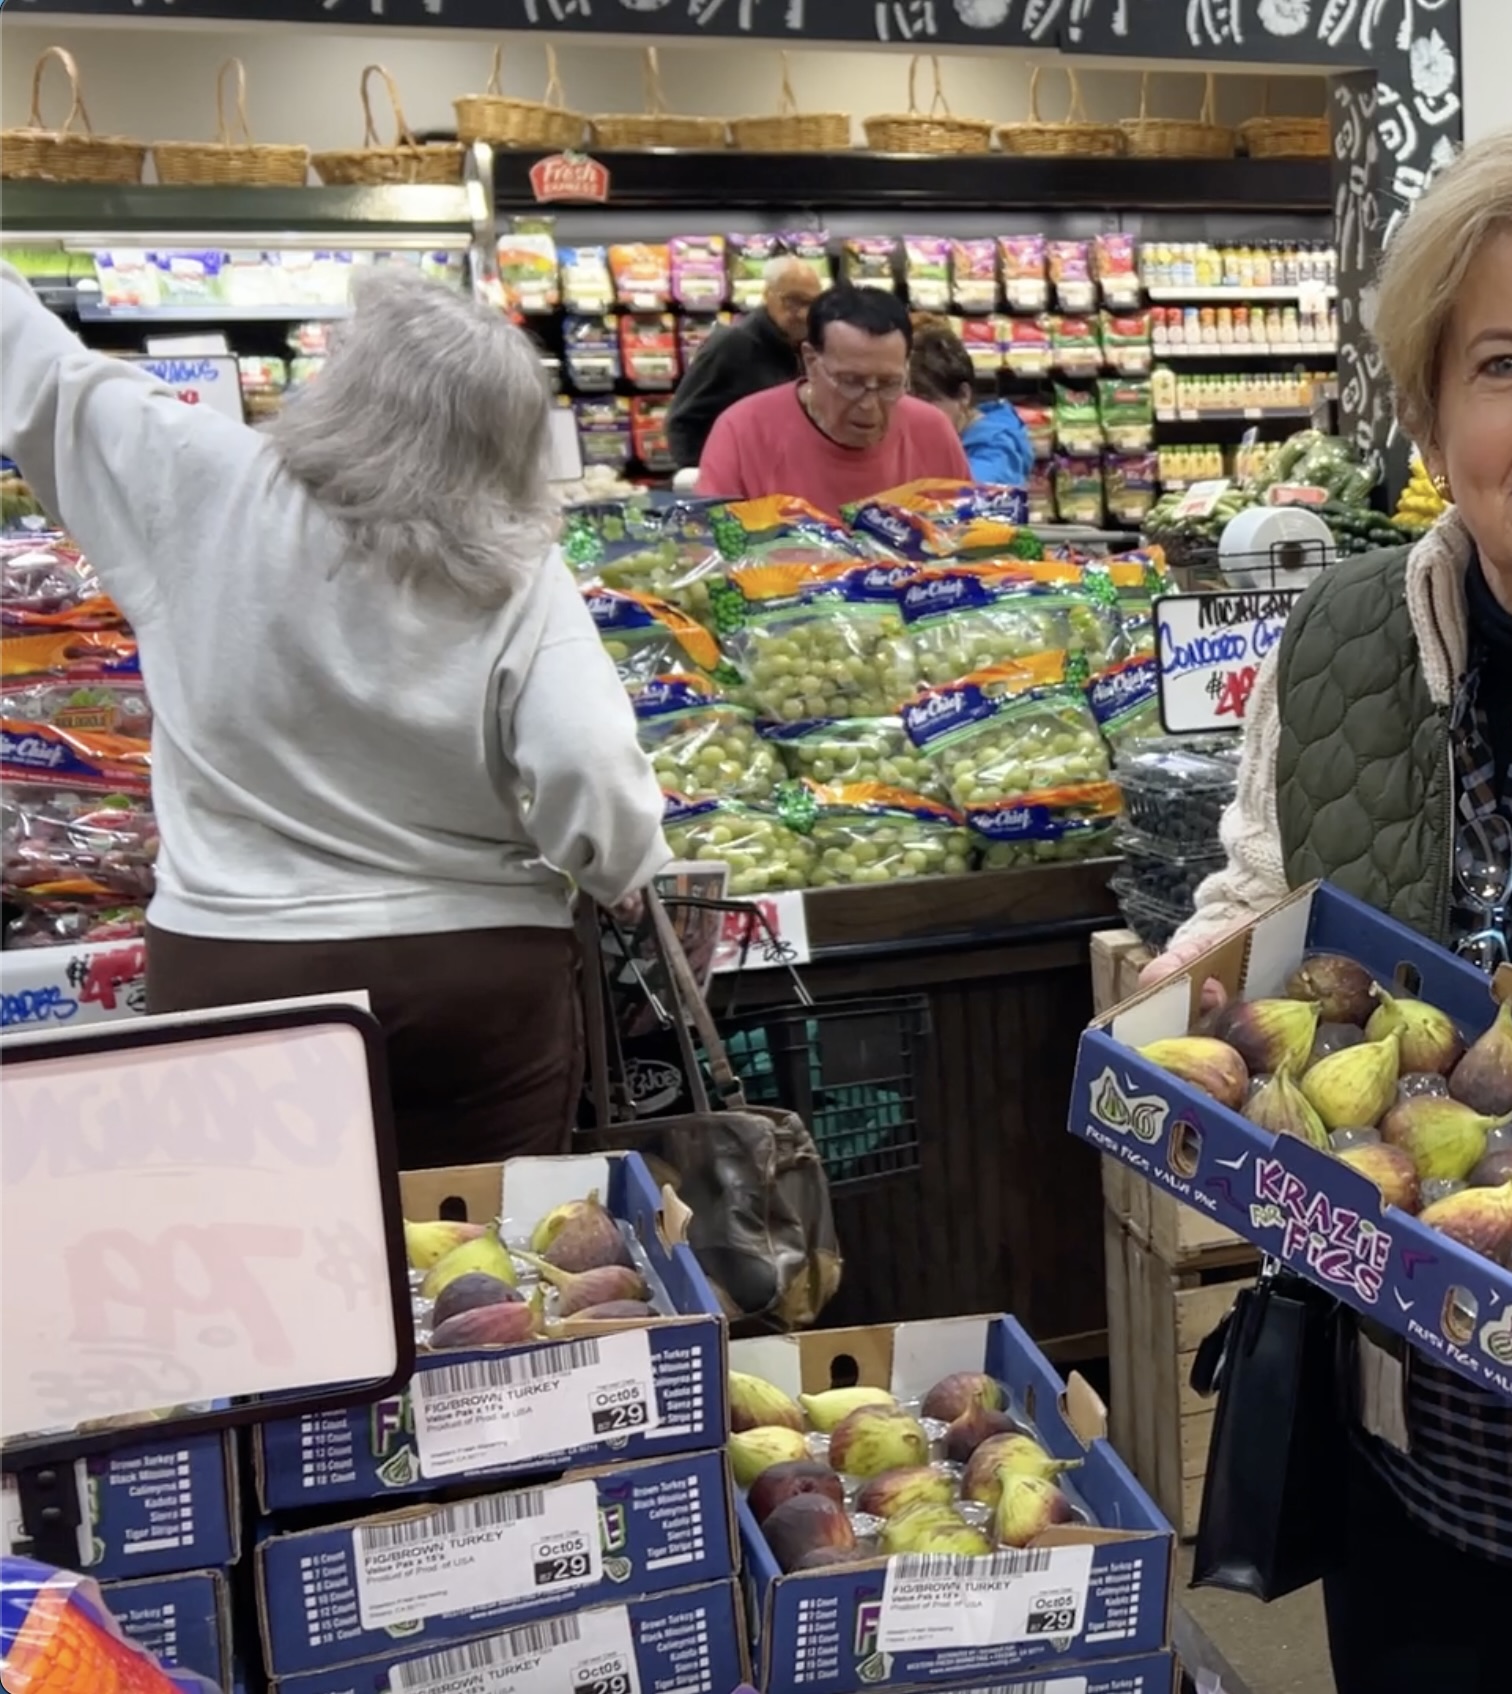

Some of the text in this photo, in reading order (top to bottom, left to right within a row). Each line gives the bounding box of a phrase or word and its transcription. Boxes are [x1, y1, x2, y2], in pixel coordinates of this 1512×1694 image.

[543, 161, 598, 183] Fresh
[927, 578, 965, 601] Chief
[1255, 1157, 1393, 1271] KRAZIE
[1281, 1217, 1384, 1304] FIGS
[423, 1380, 560, 1415] FIG/BROWN TURKEY
[594, 1386, 641, 1407] Oct05
[609, 1403, 645, 1429] 29
[143, 1453, 176, 1467] Turkey
[149, 1511, 179, 1522] Sierra
[125, 1527, 149, 1540] Tiger
[364, 1530, 504, 1566] FIG/BROWN TURKEY
[538, 1539, 584, 1558] Oct05
[320, 1550, 346, 1565] Count
[453, 1555, 476, 1568] USA
[321, 1563, 347, 1578] Count
[552, 1556, 588, 1582] 29
[323, 1576, 349, 1591] Count
[892, 1580, 1010, 1594] FIG/BROWN TURKEY
[330, 1588, 355, 1603] Count
[1035, 1595, 1074, 1609] Oct05
[331, 1601, 357, 1617] Count
[333, 1614, 358, 1629] Count
[1042, 1610, 1072, 1631] 29
[336, 1627, 362, 1641] Count
[488, 1658, 542, 1678] TURKEY
[577, 1660, 622, 1681] Oct05
